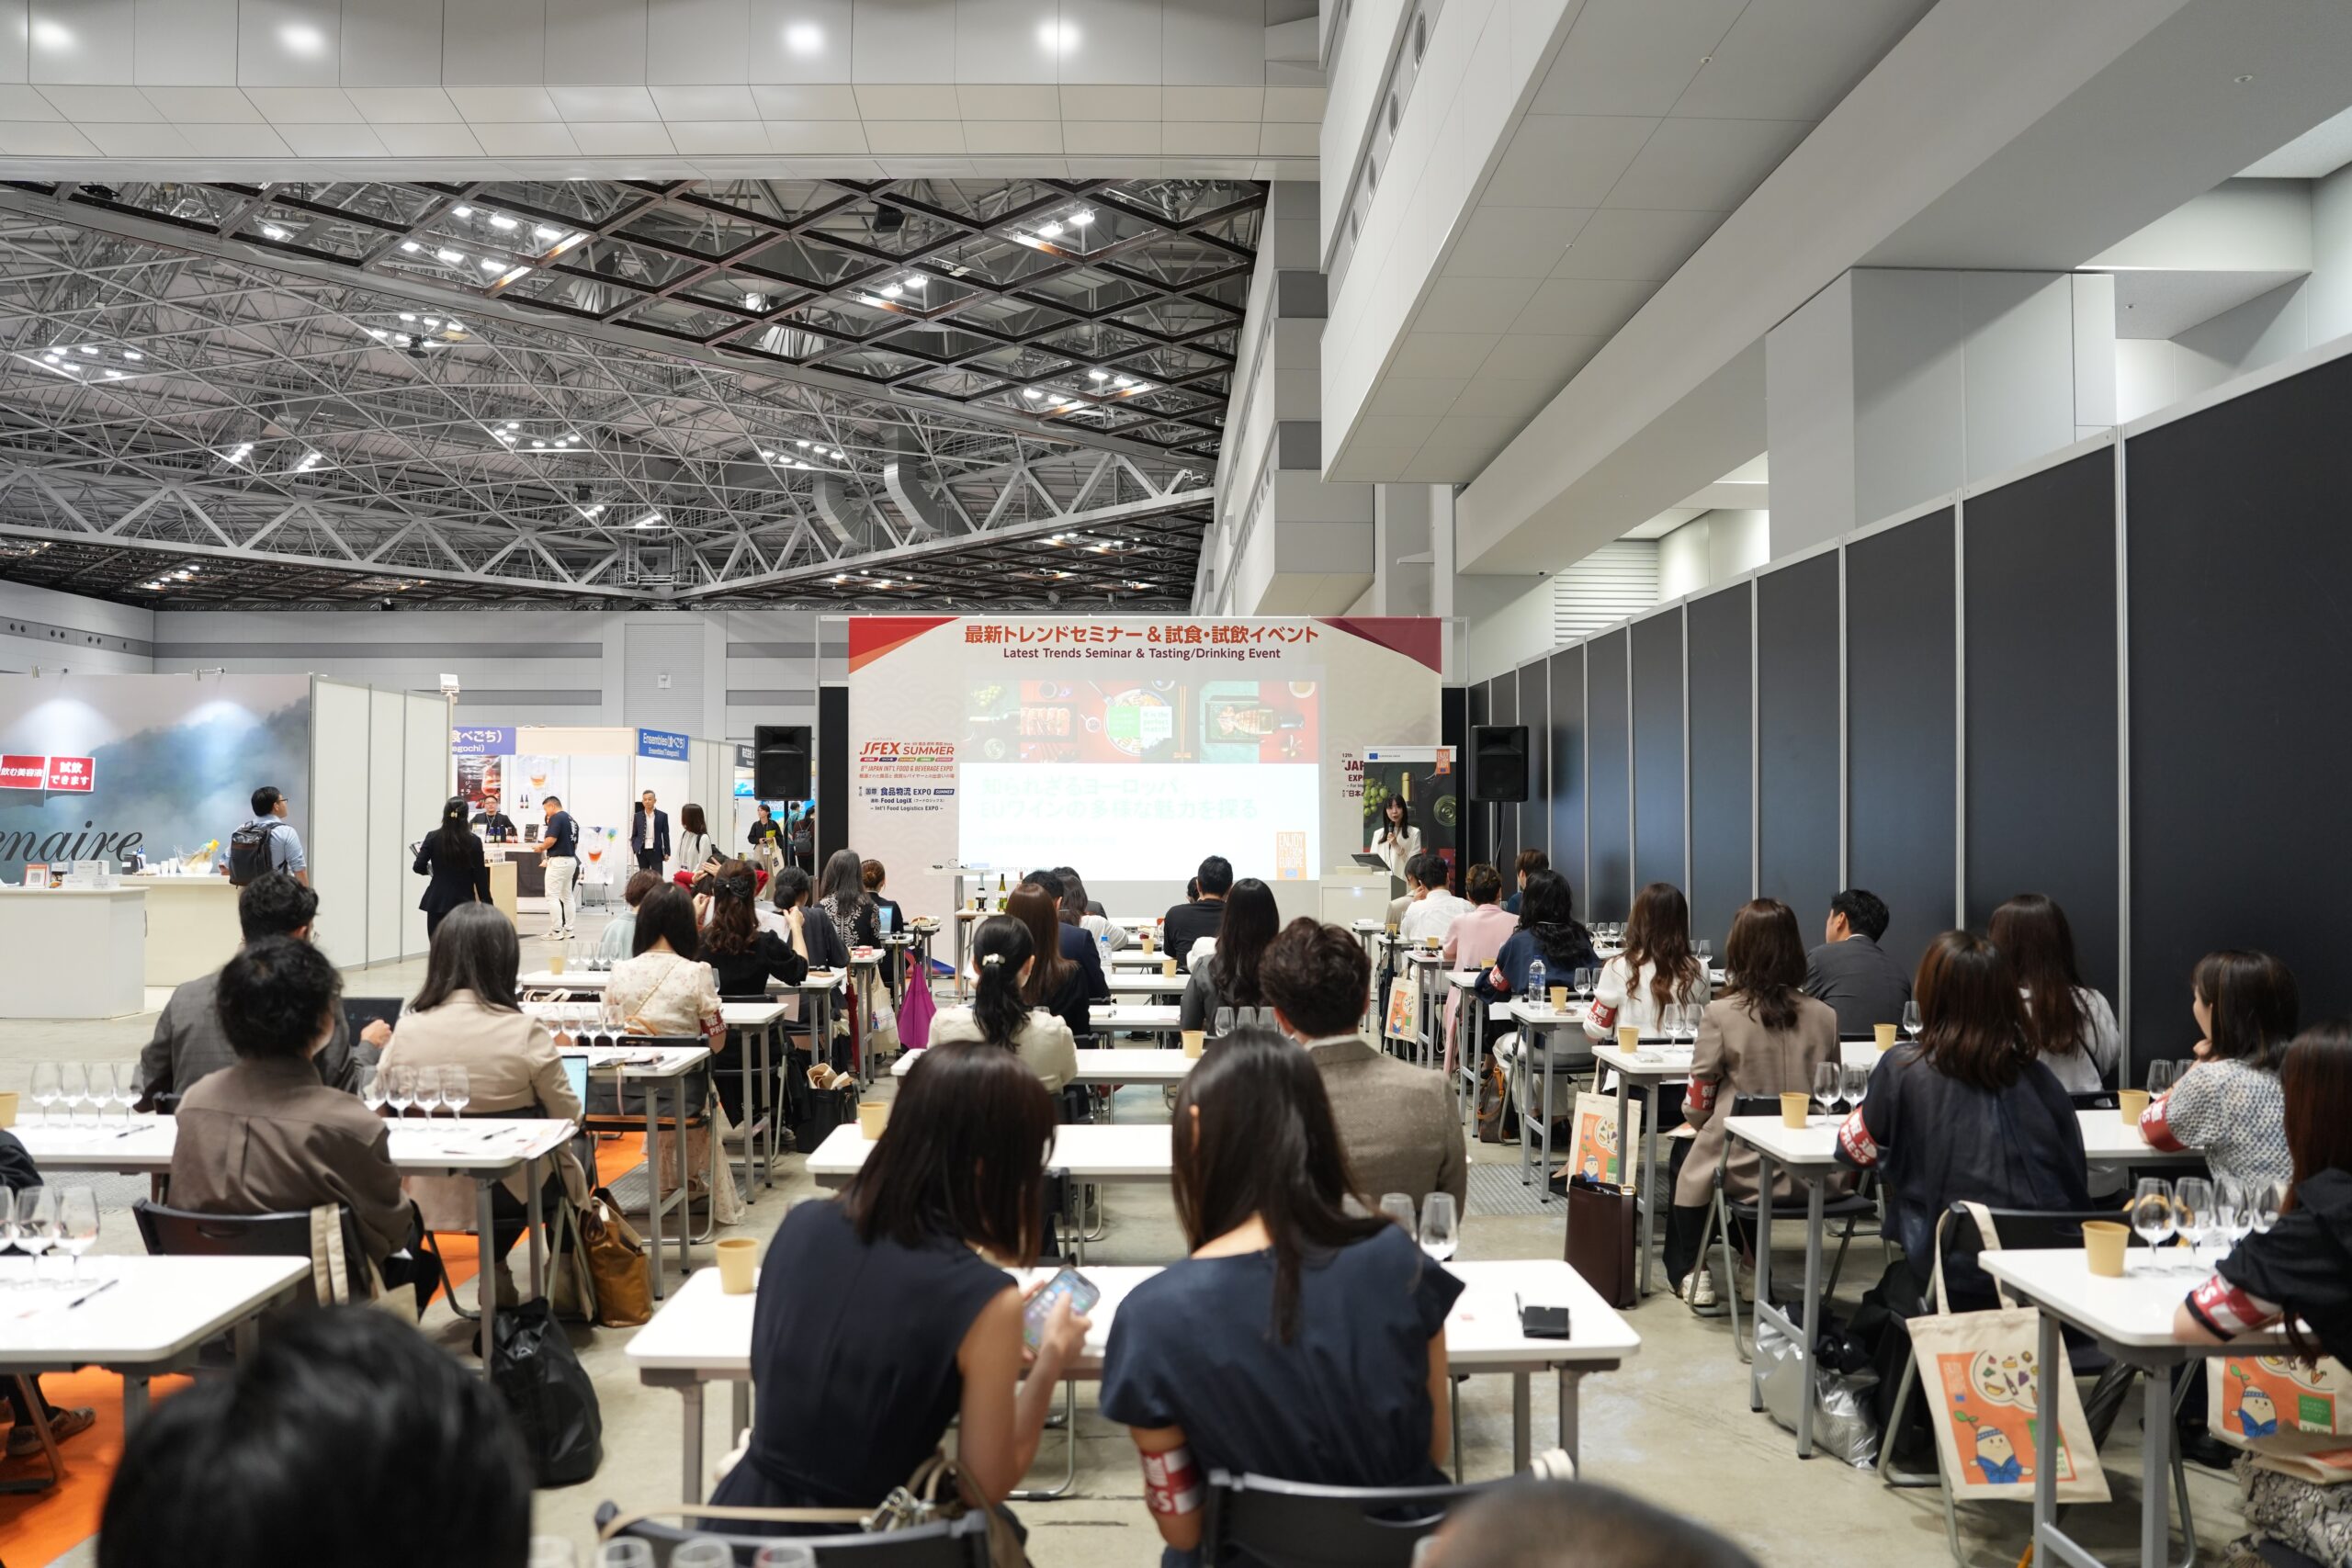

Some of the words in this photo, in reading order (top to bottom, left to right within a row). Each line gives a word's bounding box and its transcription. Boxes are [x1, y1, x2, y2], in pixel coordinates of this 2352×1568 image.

[965, 625, 1143, 645] 最新トレンドセミナー
[1147, 626, 1162, 644] &
[1165, 625, 1319, 645] 試食・試飲イベント
[1003, 648, 1038, 659] Latest
[1043, 648, 1081, 659] Trends
[1085, 648, 1132, 659] Seminar
[1136, 649, 1145, 659] &
[1149, 648, 1245, 661] Tasting/Drinking
[1249, 648, 1281, 659] Event
[859, 742, 901, 755] JFEX
[903, 746, 955, 755] SUMMER
[60, 761, 83, 773] 試飲
[51, 775, 89, 785] できます
[880, 787, 911, 796] 食品物流
[1278, 834, 1304, 847] ENJOY
[1278, 857, 1304, 868] EUROPE
[1839, 1123, 1870, 1164] PRESS
